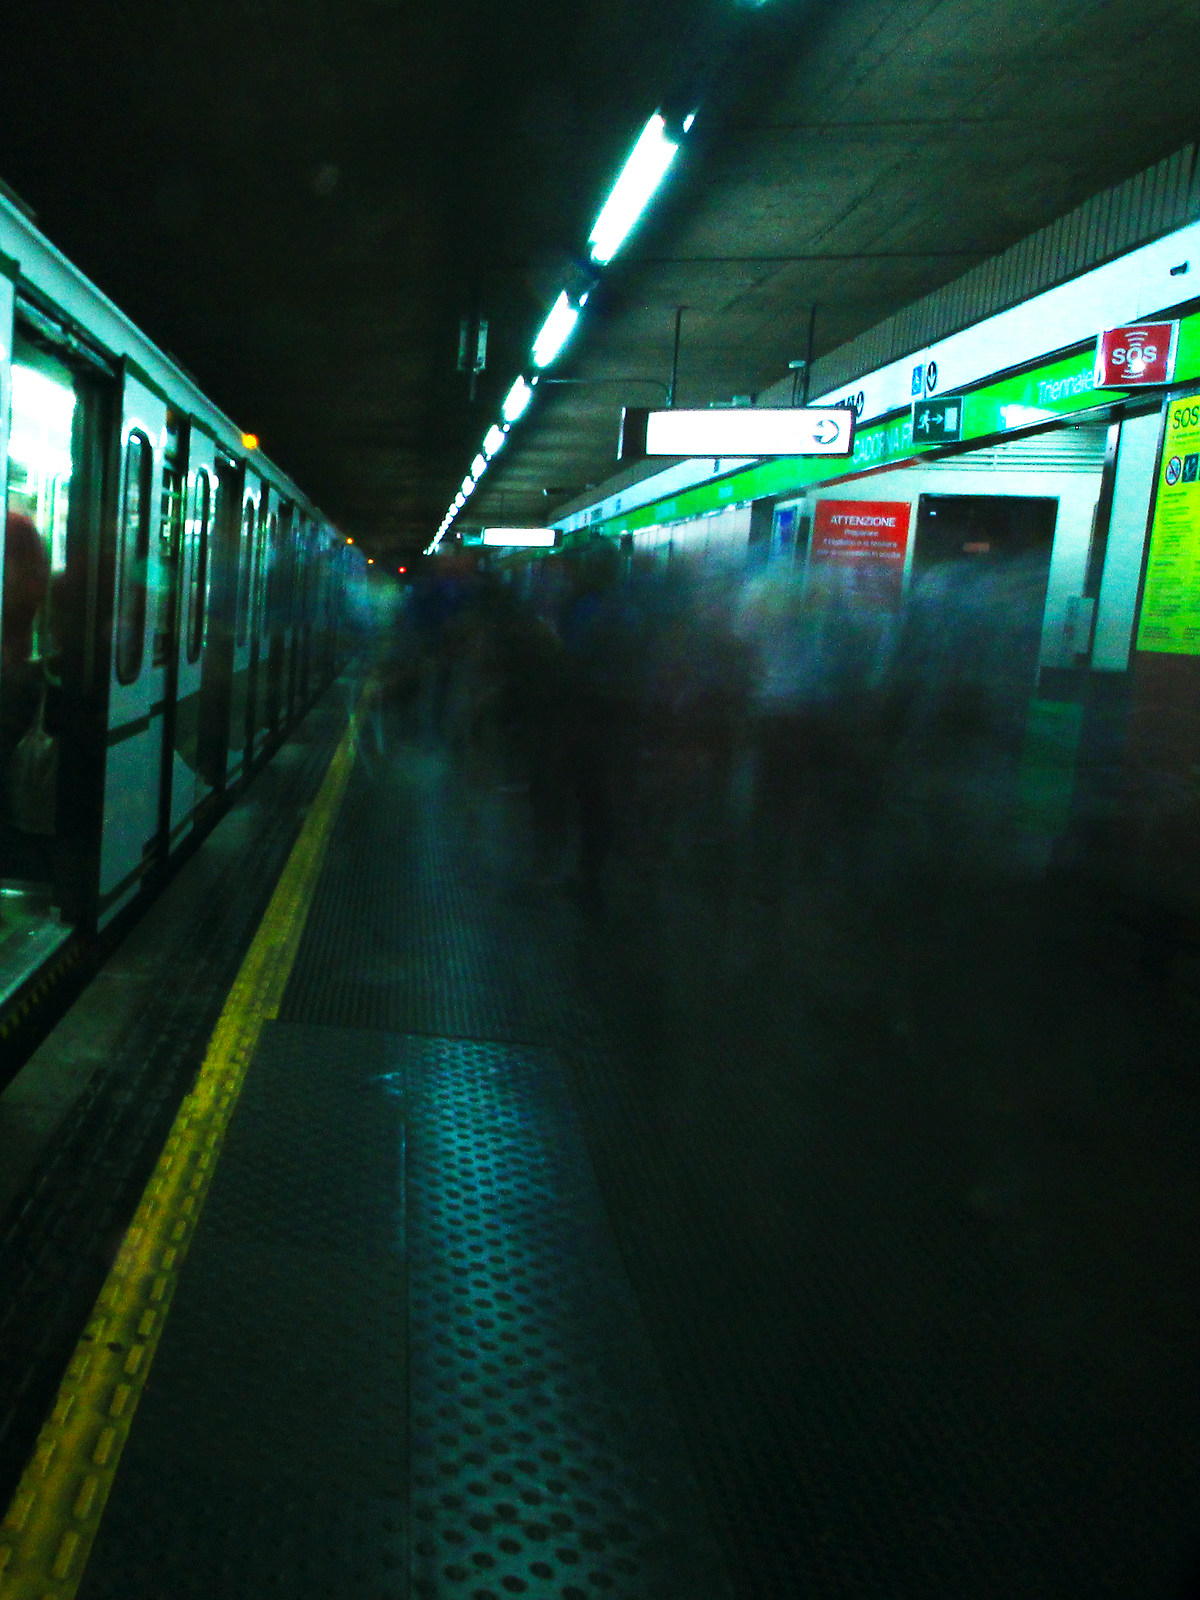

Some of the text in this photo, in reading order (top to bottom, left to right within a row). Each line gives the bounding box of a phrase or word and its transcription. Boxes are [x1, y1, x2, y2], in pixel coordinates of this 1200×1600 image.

[1111, 345, 1158, 366] SOS
[1173, 405, 1200, 430] SOS
[830, 514, 897, 528] ATTENZIONE
